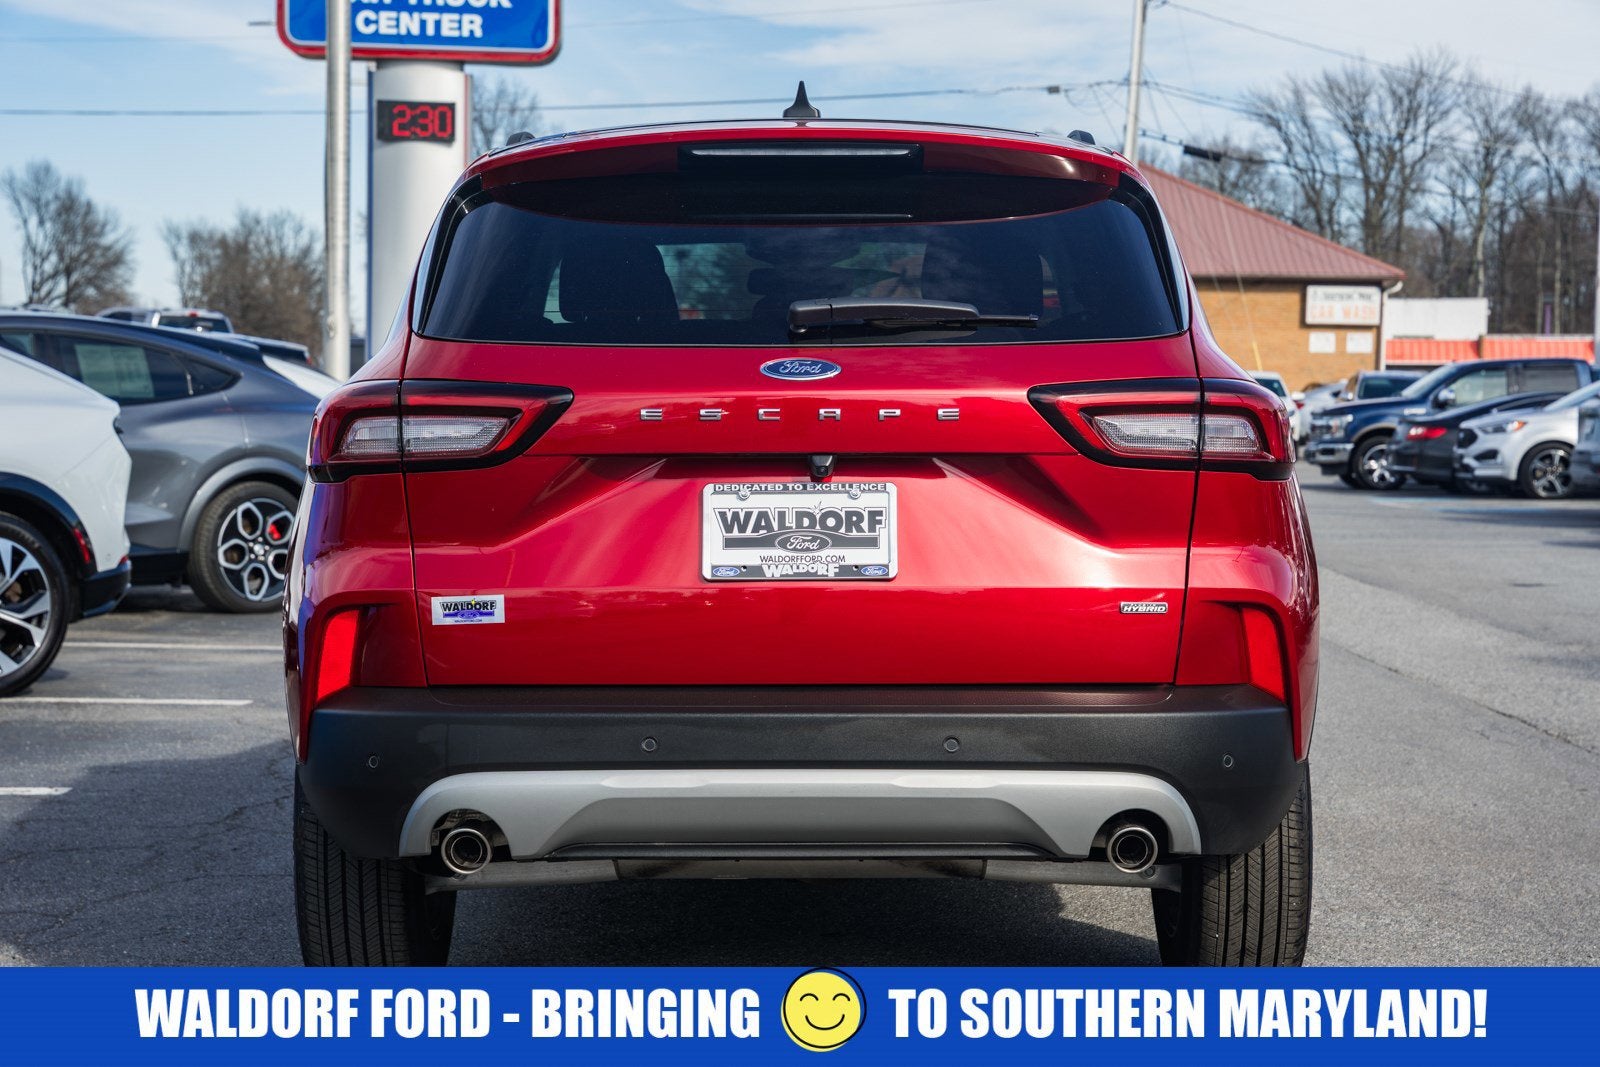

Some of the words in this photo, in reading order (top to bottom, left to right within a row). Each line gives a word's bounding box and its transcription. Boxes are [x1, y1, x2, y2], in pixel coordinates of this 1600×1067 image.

[355, 9, 483, 38] CENTER
[778, 361, 823, 374] Ford
[640, 408, 960, 421] ESCAPE
[715, 484, 783, 492] DEDICATED
[713, 507, 887, 536] WALDORF
[786, 536, 820, 550] Ford
[759, 555, 846, 563] WALDORFFORD.COM
[439, 600, 497, 612] WALDORF
